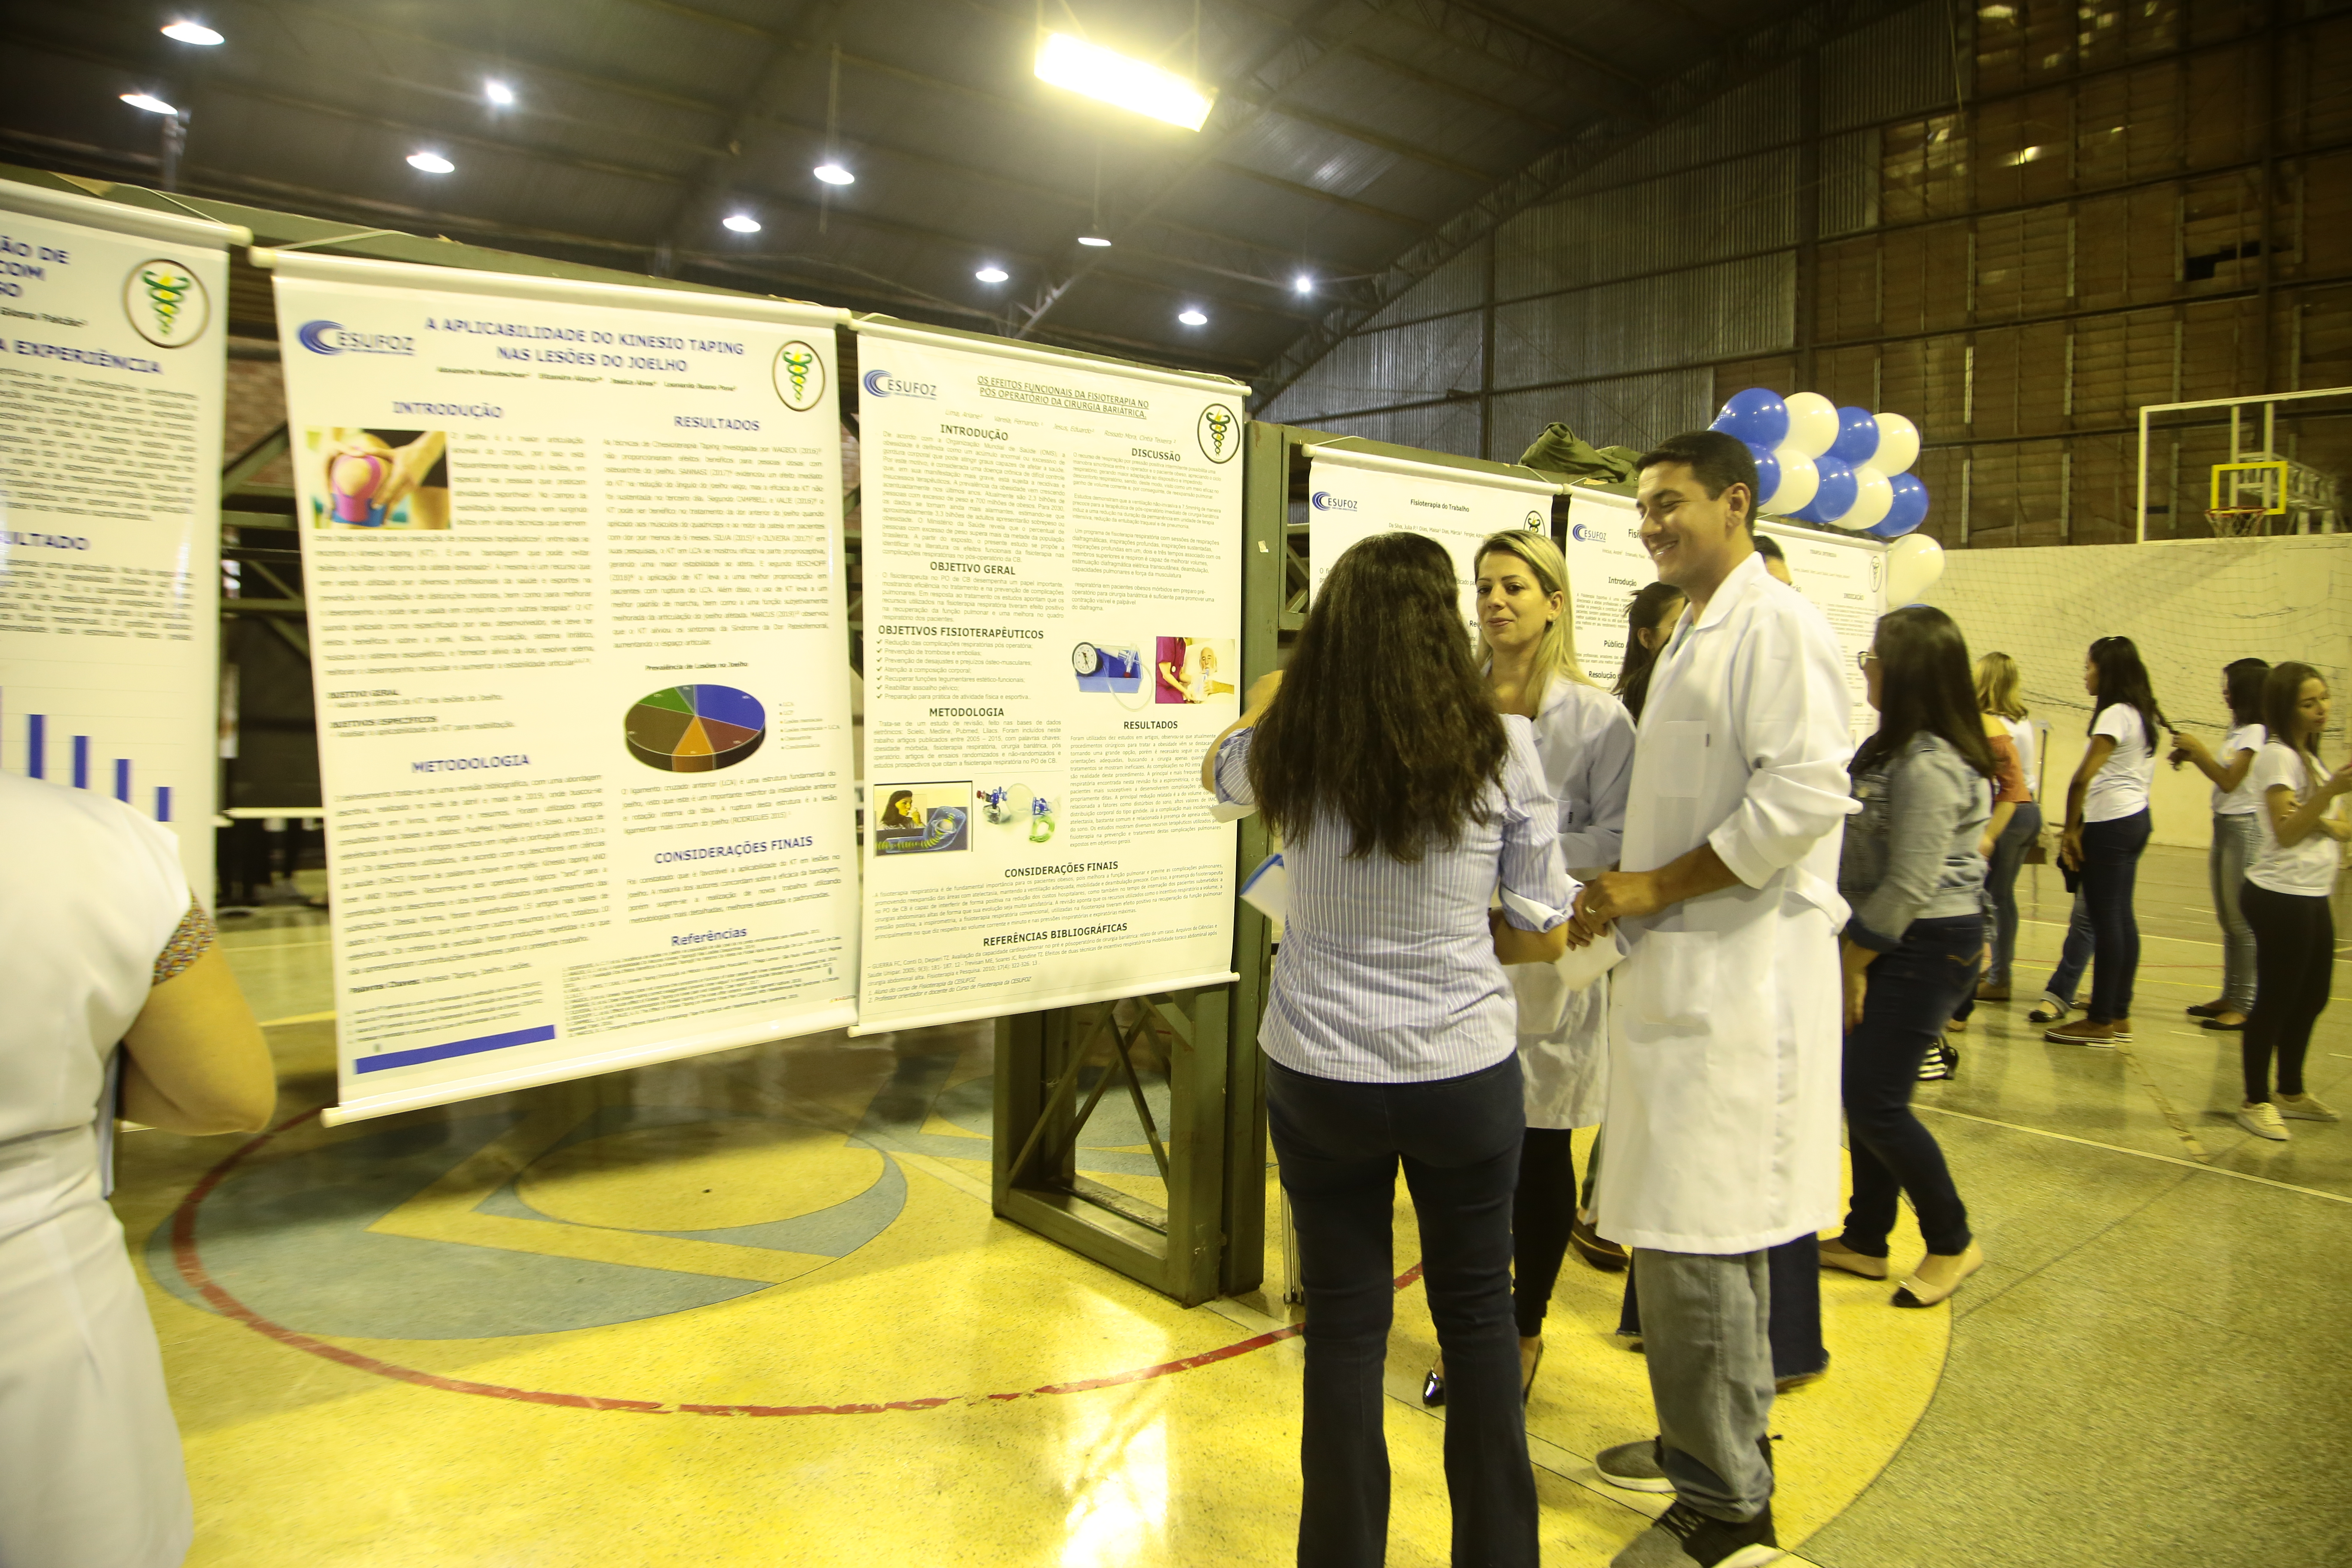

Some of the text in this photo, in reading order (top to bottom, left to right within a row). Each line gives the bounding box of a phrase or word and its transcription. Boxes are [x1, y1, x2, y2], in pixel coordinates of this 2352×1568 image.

[38, 246, 70, 265] DE
[424, 317, 745, 355] A APLICABILIDADE DO KINESIO TAPING
[14, 340, 164, 375] EXPERIÊNCIA
[496, 347, 687, 372] NAS LESÕES DO JOELHO
[977, 377, 1148, 409] OS EFEITOS FUNCIONAIS DA FISIOTERAPIA NO
[392, 402, 503, 417] INTRODUÇÃO
[979, 386, 1146, 419] PÓS OPERATÓRIO DA CIRURGIA BARIÁTRICA.
[673, 416, 761, 430] RESULTADOS
[940, 424, 1008, 440] INTRODUÇÃO
[1131, 448, 1180, 461] DISCUSSÃO
[1410, 499, 1440, 508] Fisioterapia
[1449, 504, 1469, 512] Trabalho
[930, 561, 1015, 575] OBJETIVO GERAL
[1608, 576, 1637, 586] Introdução
[878, 625, 1044, 638] OBJETIVOS FISIOTERAPÊUTICOS
[1588, 671, 1616, 679] Resolução
[929, 707, 1004, 717] METODOLOGIA
[1124, 721, 1178, 729] RESULTADOS
[410, 755, 530, 772] METODOLOGIA
[654, 836, 813, 863] CONSIDERAÇÕES FINAIS
[1004, 861, 1118, 877] CONSIDERAÇÕES FINAIS
[671, 928, 748, 945] Referências
[983, 923, 1127, 946] REFERÊNCIAS BIBLIOGRÁFICAS
